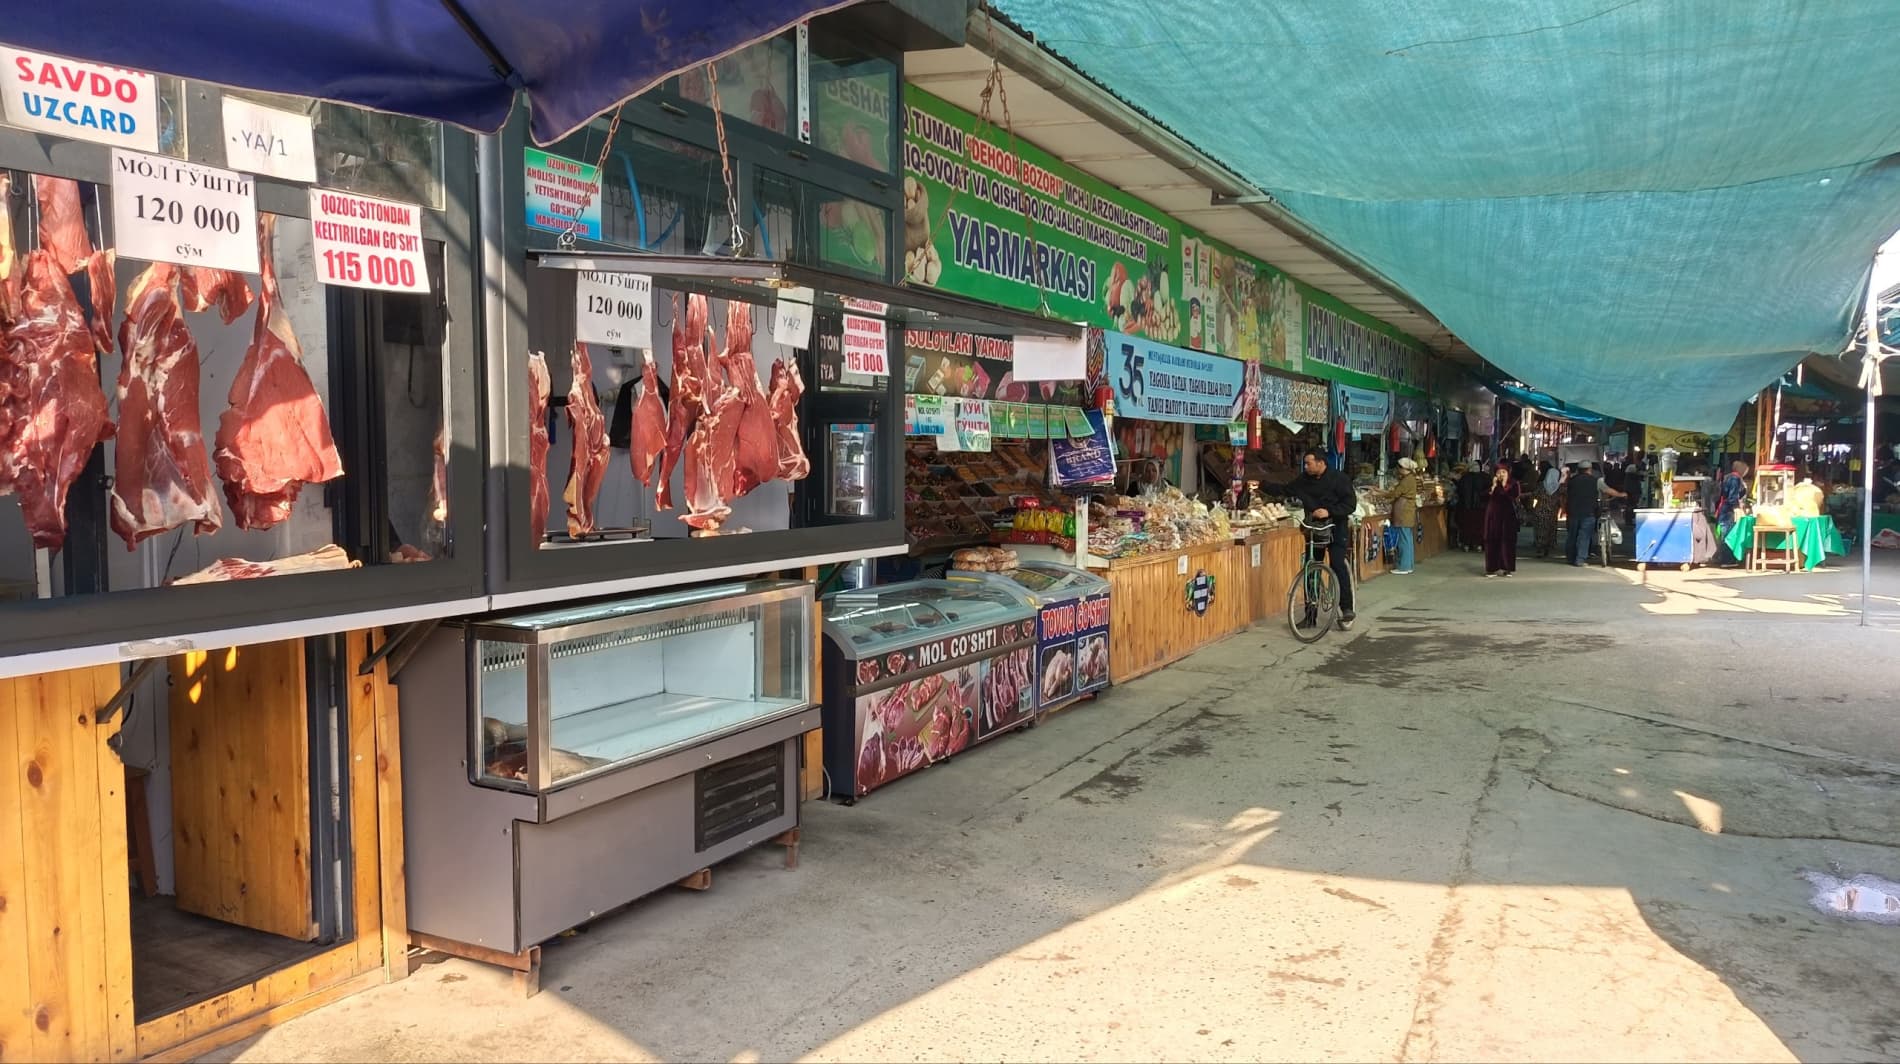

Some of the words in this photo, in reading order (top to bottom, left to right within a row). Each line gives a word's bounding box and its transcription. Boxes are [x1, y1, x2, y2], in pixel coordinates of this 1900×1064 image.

[15, 57, 138, 104] SAVDO
[22, 91, 137, 136] UZCARD
[118, 157, 167, 181] МОЛ
[175, 168, 249, 196] ГЎШТИ
[912, 110, 963, 155] TUMAN
[1064, 183, 1090, 213] MCHJ
[1091, 194, 1170, 249] ARZONLASHTIRILGAN
[135, 194, 184, 225] 120
[194, 205, 241, 234] 000
[903, 142, 970, 196] IQ-OVQAT
[972, 173, 990, 202] VA
[991, 181, 1040, 224] QISHLOQ
[1085, 222, 1148, 263] MAHSULOTLARI
[176, 243, 203, 259] сўм
[314, 221, 381, 251] KELTIRILGAN
[323, 249, 364, 284] 115
[368, 256, 417, 288] 000
[948, 208, 1097, 304] YARMARKASI
[588, 294, 613, 316] 120
[617, 300, 643, 321] 000
[847, 351, 861, 371] 115
[863, 353, 883, 373] 000
[1041, 607, 1076, 641] TOVUQ
[919, 642, 947, 668] MOL
